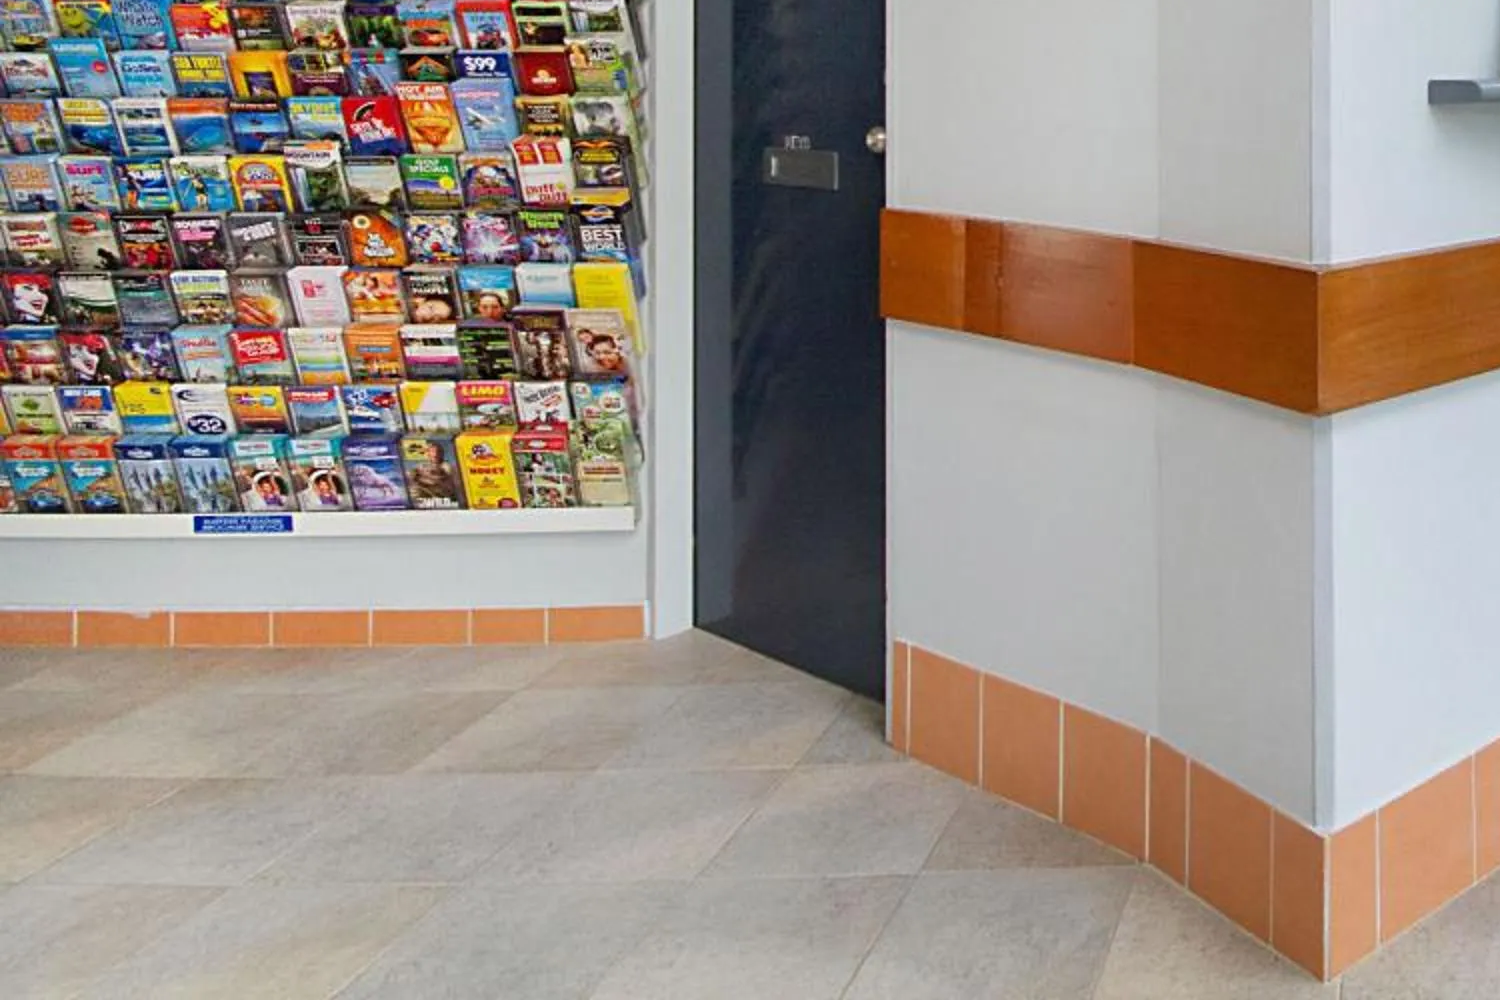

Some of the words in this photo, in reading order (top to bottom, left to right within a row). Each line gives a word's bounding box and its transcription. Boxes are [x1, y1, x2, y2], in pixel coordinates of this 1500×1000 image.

[463, 56, 497, 71] $99
[65, 164, 104, 175] Surf
[581, 229, 623, 242] BEST
[461, 385, 505, 396] LIMO
[190, 416, 224, 432] $32
